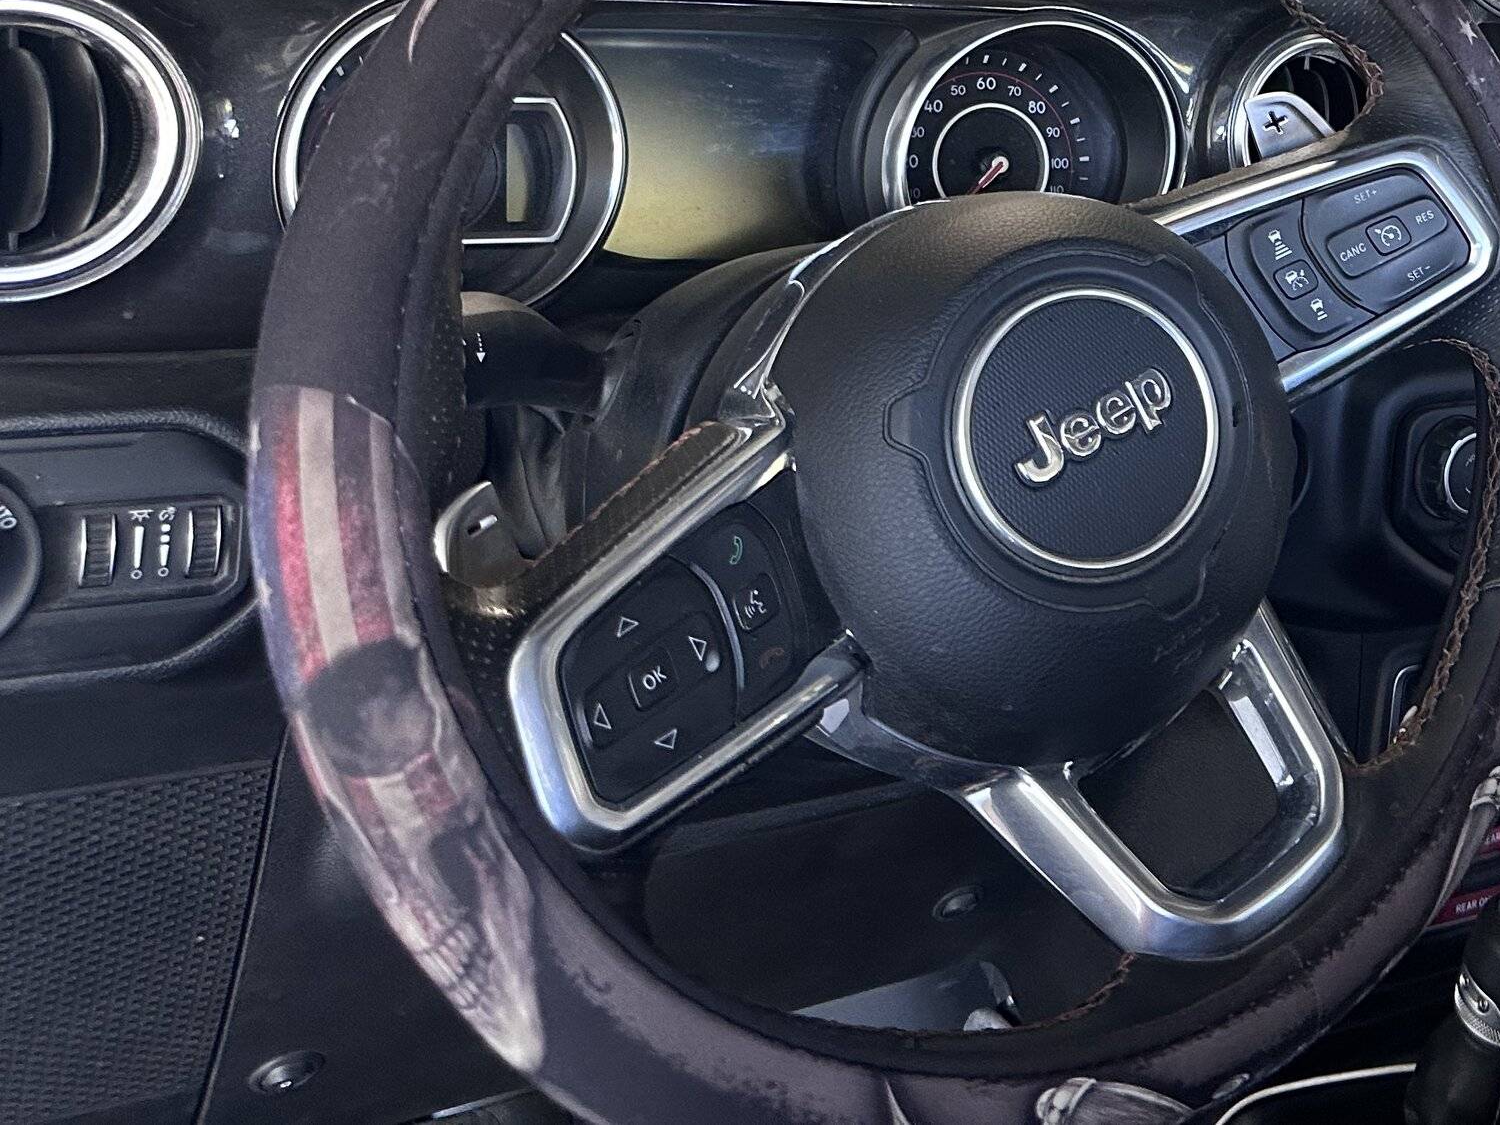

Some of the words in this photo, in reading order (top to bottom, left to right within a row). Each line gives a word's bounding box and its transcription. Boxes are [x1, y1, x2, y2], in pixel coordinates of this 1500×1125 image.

[950, 84, 966, 96] 50
[976, 77, 996, 91] 60
[1007, 85, 1022, 97] 70
[924, 100, 943, 113] 40
[1028, 101, 1046, 114] 80
[1046, 127, 1060, 138] 90
[1051, 158, 1069, 169] 100
[1415, 210, 1434, 224] RES
[1339, 243, 1366, 262] CANC
[1013, 367, 1173, 487] Jeep
[642, 666, 667, 691] OK
[1456, 900, 1477, 914] REAR
